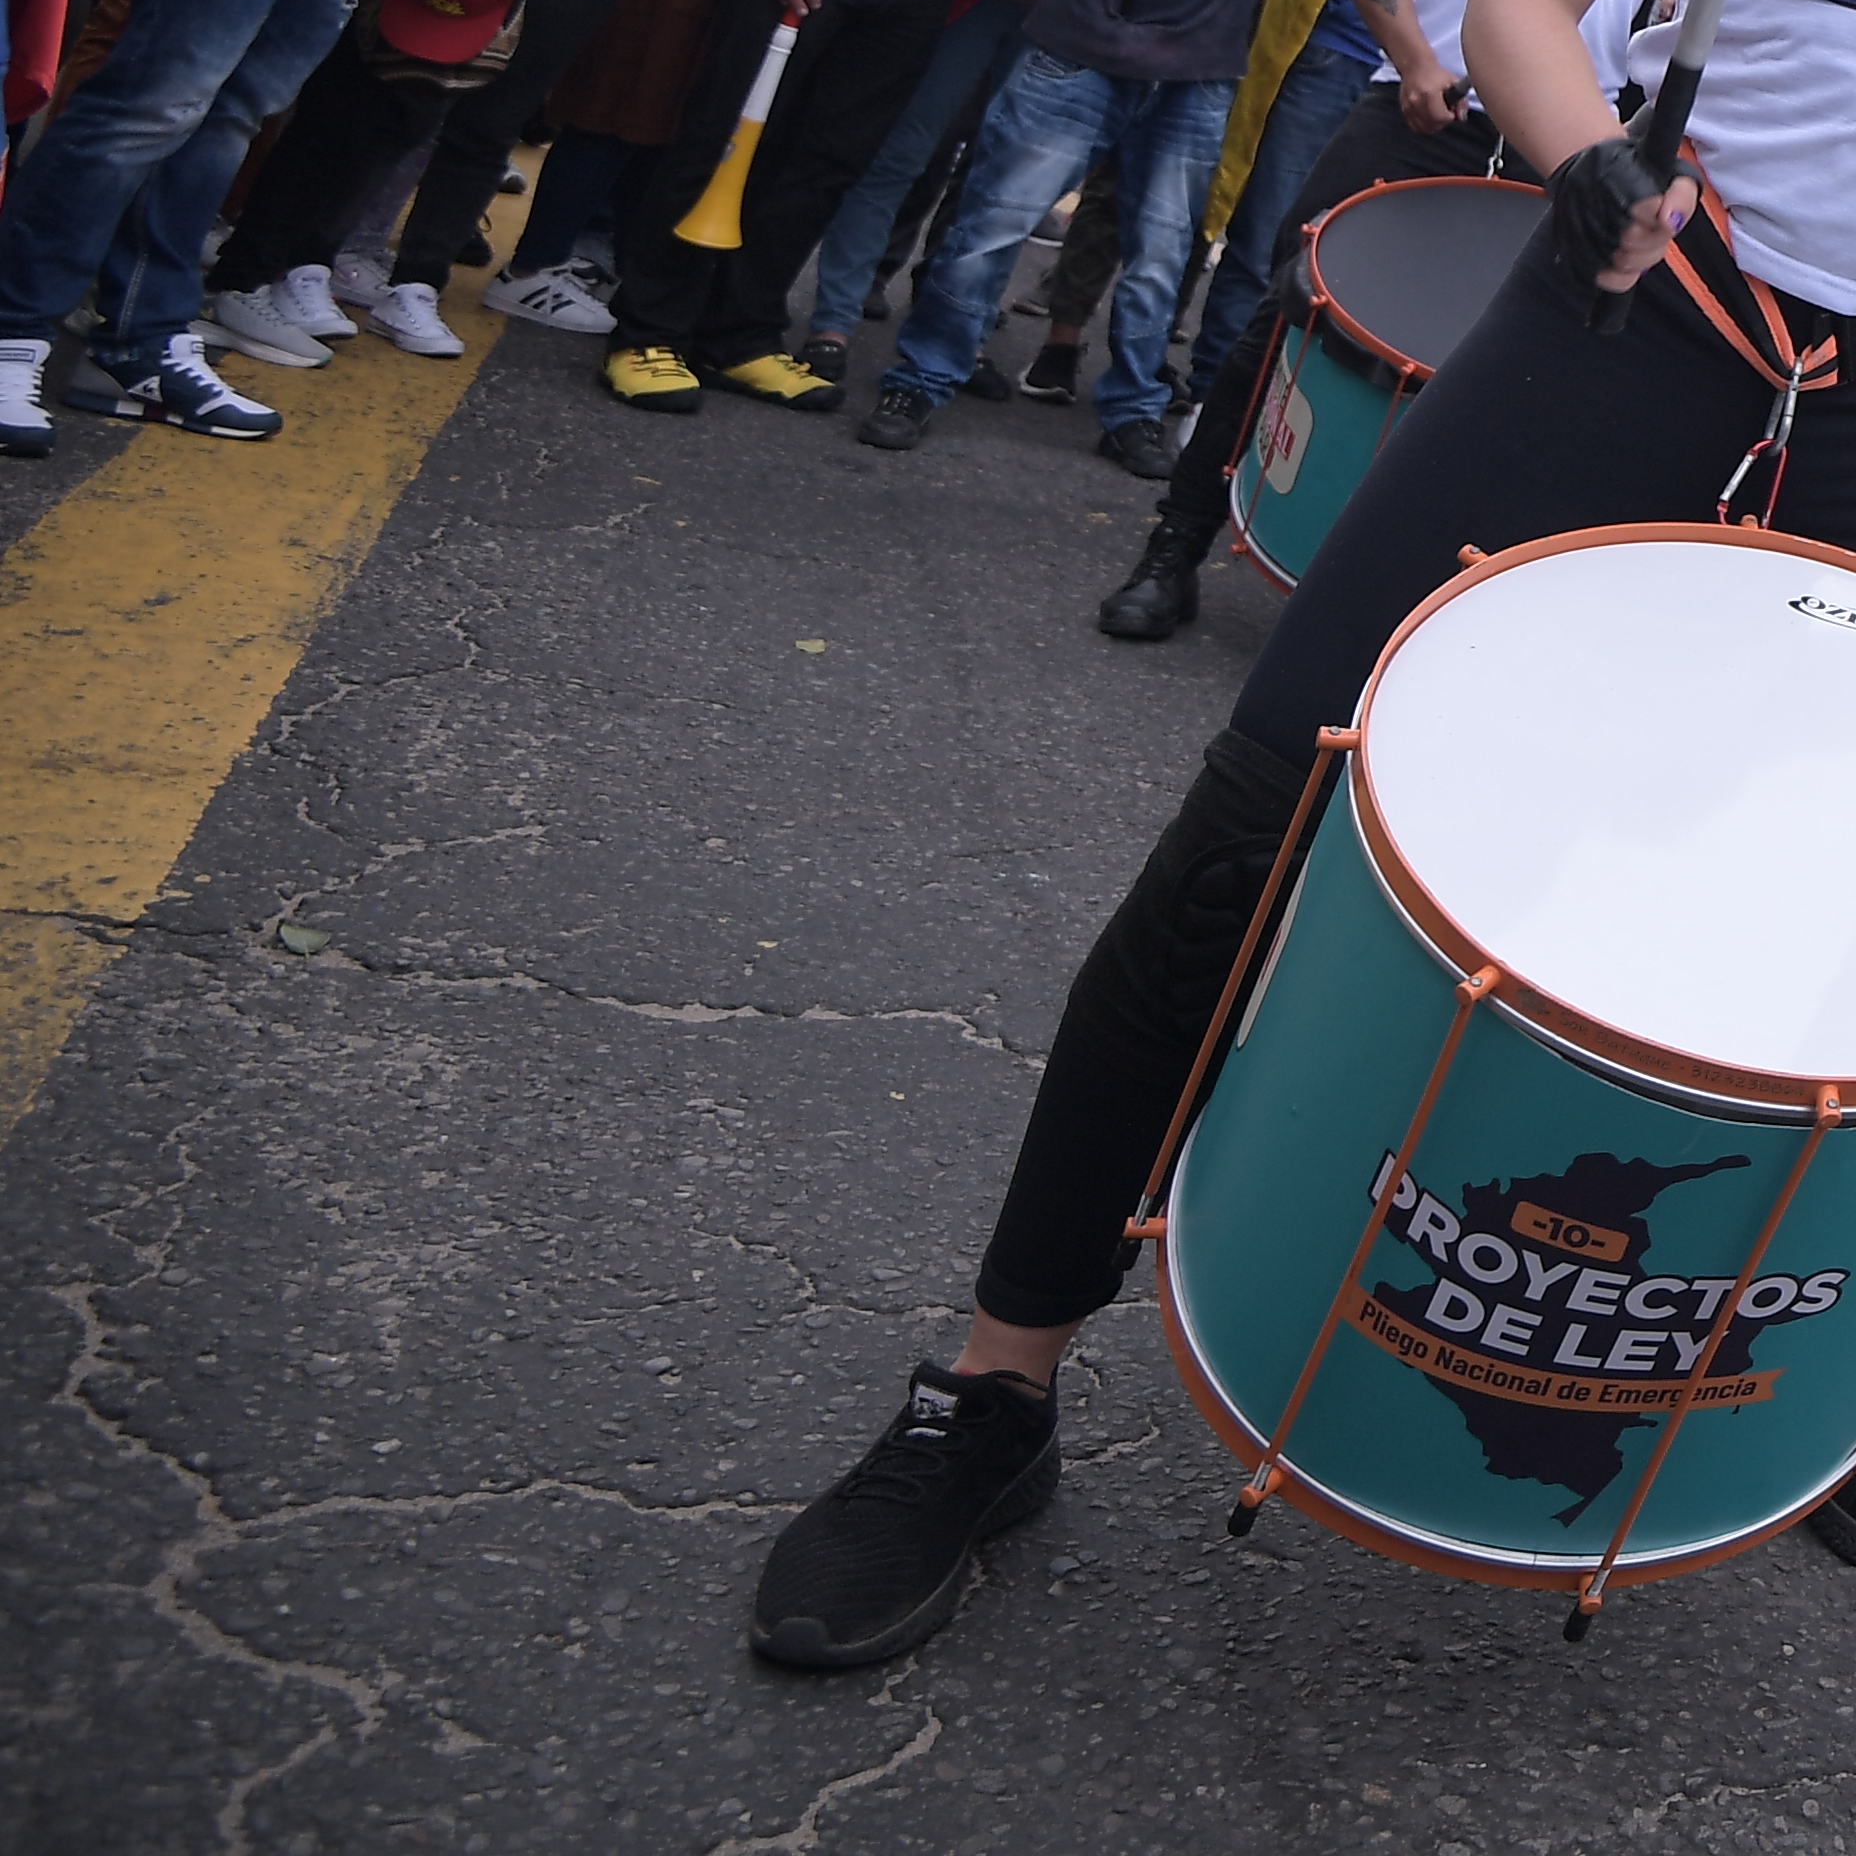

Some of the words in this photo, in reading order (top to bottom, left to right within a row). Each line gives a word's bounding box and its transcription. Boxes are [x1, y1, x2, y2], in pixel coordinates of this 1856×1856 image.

[1368, 1150, 1849, 1322] PROYECTOS
[1359, 1300, 1429, 1360] Pliego
[1434, 1345, 1552, 1398] Nacional
[1556, 1379, 1592, 1403] de
[1424, 1276, 1544, 1357] DE
[1553, 1321, 1731, 1372] LEY
